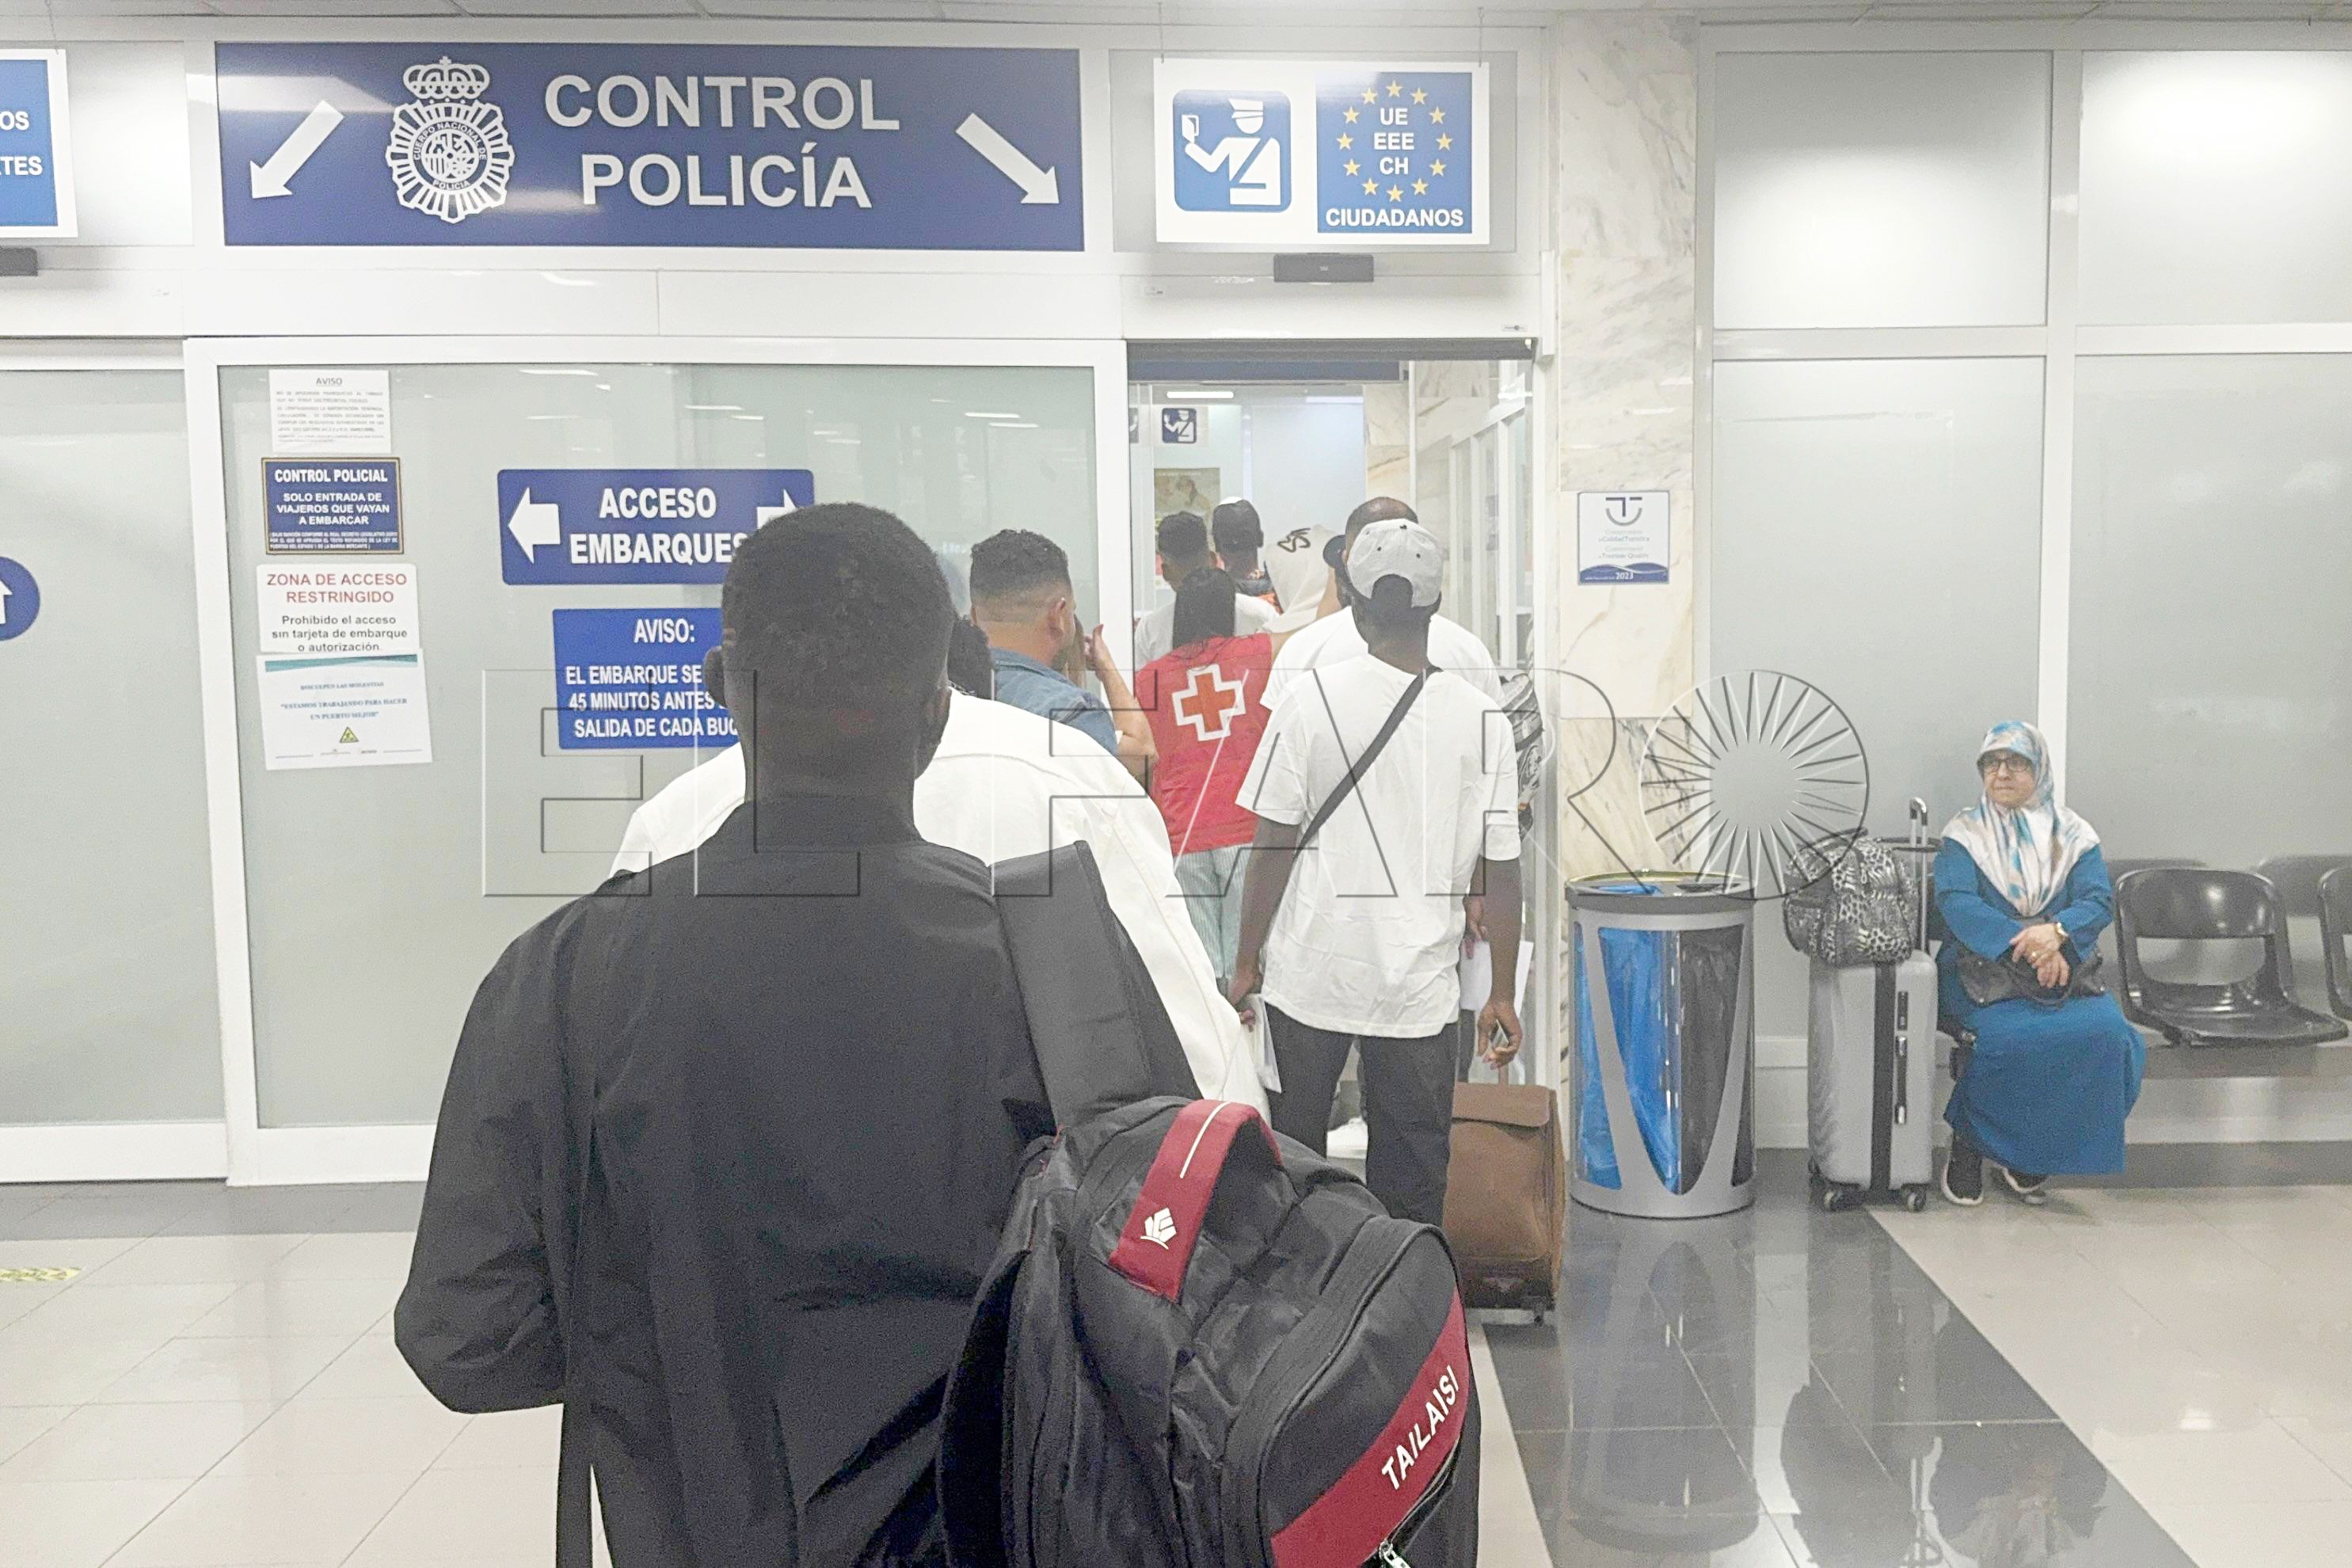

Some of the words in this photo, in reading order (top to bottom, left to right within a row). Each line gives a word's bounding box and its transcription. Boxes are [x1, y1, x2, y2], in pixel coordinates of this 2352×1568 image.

[545, 74, 900, 131] CONTROL
[1380, 108, 1408, 126] UE
[413, 127, 435, 160] CUERPO
[437, 123, 481, 147] NACIONAL
[479, 148, 486, 160] DE
[1374, 133, 1414, 150] EEE
[0, 156, 43, 175] TES
[1380, 157, 1408, 175] CH
[582, 143, 872, 208] POLICÍA
[1326, 207, 1463, 227] CIUDADANOS
[275, 469, 331, 482] CONTROL
[334, 469, 388, 482] POLICIAL
[315, 493, 365, 501] ENTRADA
[367, 493, 382, 501] DE
[599, 487, 717, 519] ACCESO
[277, 504, 329, 513] VIAJEROS
[331, 504, 354, 513] QUE
[356, 504, 390, 513] VAYAN
[267, 573, 310, 586] ZONA
[315, 573, 336, 586] DE
[341, 573, 407, 586] ACCESO
[286, 591, 394, 603] RESTRINGIDO
[282, 615, 338, 625] Prohibido
[341, 615, 352, 625] el
[272, 630, 289, 639] sin
[293, 630, 329, 640] tarjeta
[333, 629, 346, 638] de
[350, 629, 407, 639] embarque
[634, 618, 695, 643] AVISO:
[309, 642, 379, 653] autorización
[566, 665, 586, 685] EL
[588, 664, 679, 685] EMBARQUE
[681, 664, 702, 683] SE
[569, 692, 587, 710] 45
[590, 691, 660, 711] MINUTOS
[664, 691, 715, 710] ANTES
[574, 718, 633, 738] SALIDA
[636, 718, 657, 737] DE
[660, 718, 704, 737] CADA
[1380, 1365, 1460, 1490] TAILAISI
